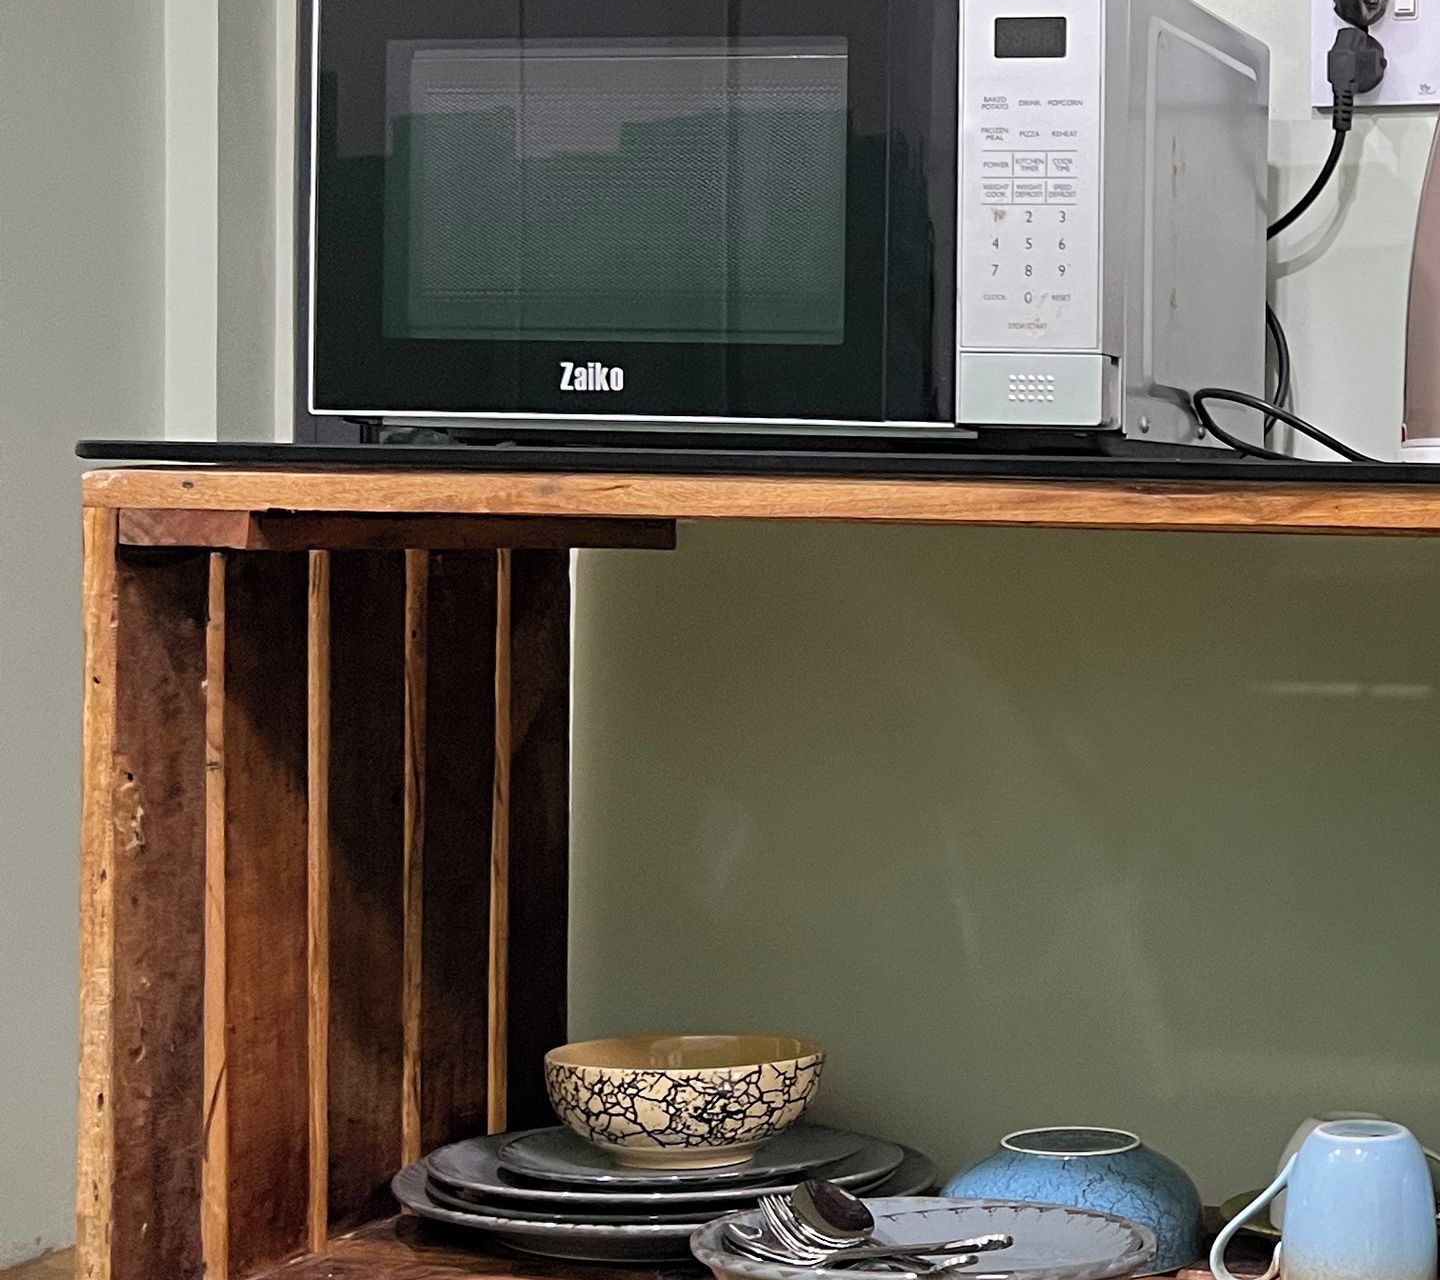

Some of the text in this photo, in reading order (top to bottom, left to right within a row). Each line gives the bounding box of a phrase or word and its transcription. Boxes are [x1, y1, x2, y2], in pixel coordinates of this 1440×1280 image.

[1025, 210, 1033, 223] 2
[1059, 210, 1066, 223] 3
[992, 237, 1066, 250] 4 5 6
[991, 264, 1066, 277] 7 8 9
[1024, 291, 1033, 304] 0
[559, 361, 624, 391] Zaiko
